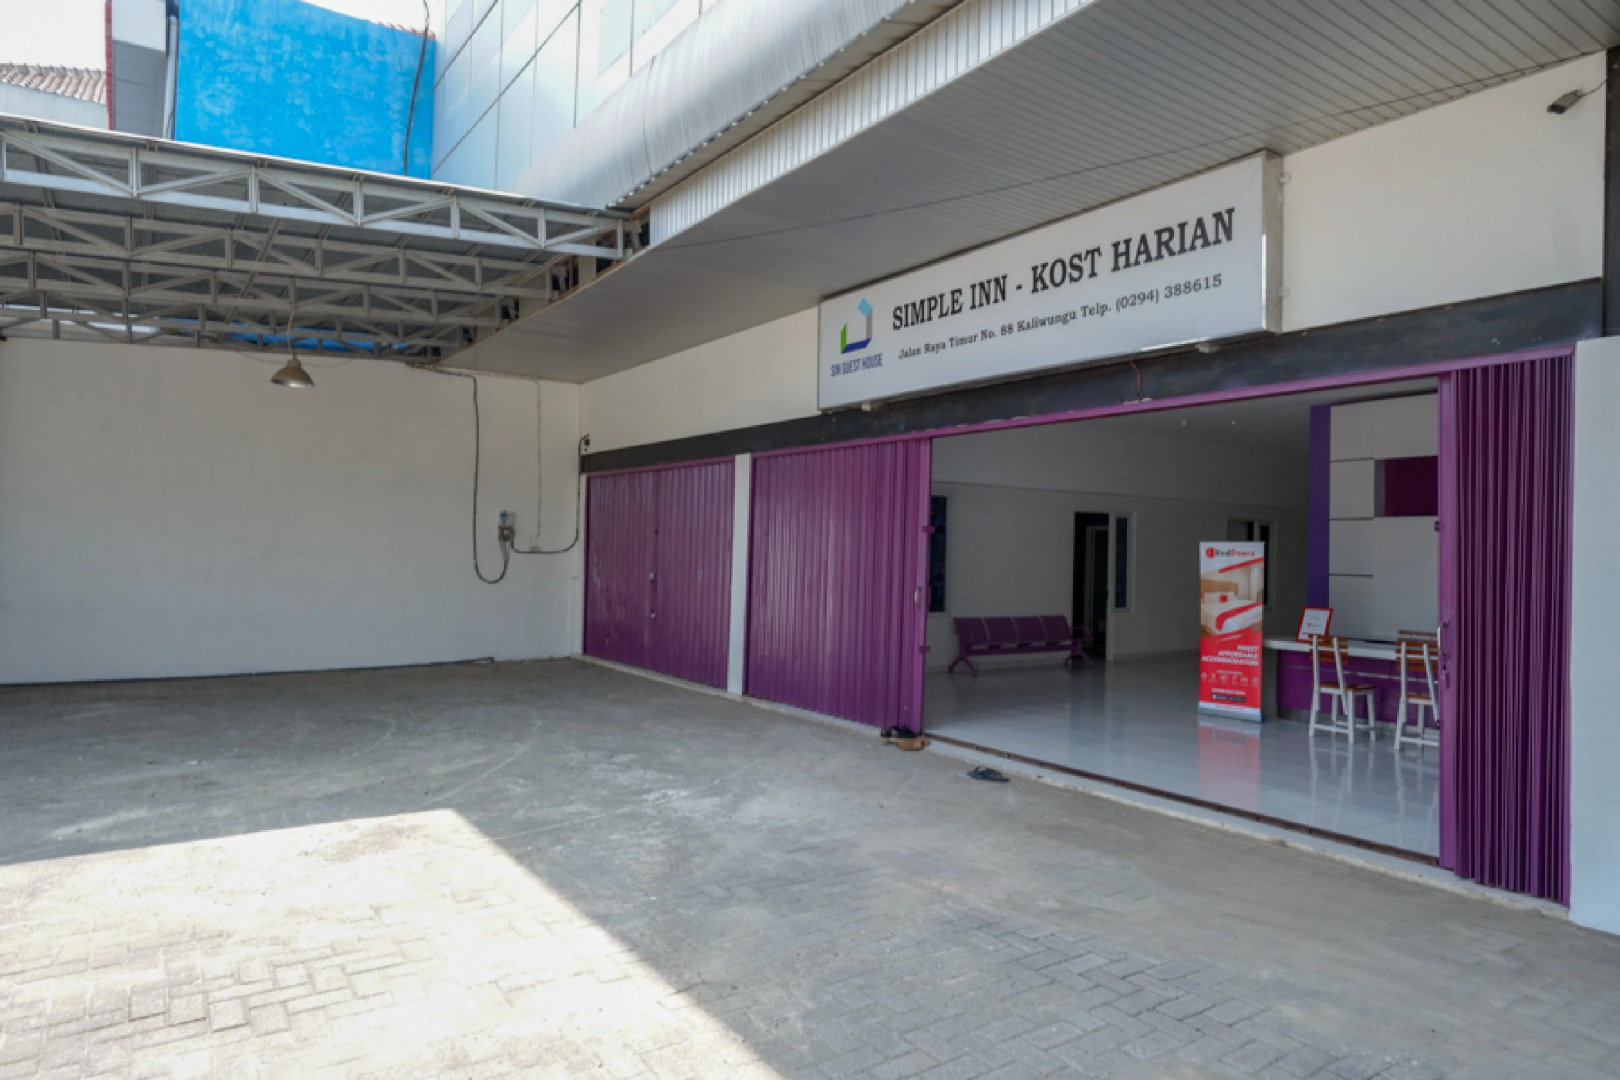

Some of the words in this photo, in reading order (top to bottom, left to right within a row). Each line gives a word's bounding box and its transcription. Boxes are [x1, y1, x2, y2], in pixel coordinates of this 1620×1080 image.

[893, 288, 963, 331] SIMPLE
[970, 274, 1008, 310] INN
[1031, 247, 1102, 294] KOST
[1111, 207, 1235, 273] HARIAN
[898, 344, 921, 359] Jalan
[924, 341, 947, 355] Raya
[949, 333, 978, 348] Timur
[980, 328, 997, 341] No.
[1016, 311, 1077, 334] Kaliwungu
[1081, 302, 1111, 318] Telp.
[1116, 288, 1159, 313] (0294)
[1164, 273, 1222, 300] 388615
[842, 358, 861, 375] GUEST
[862, 353, 883, 370] HOUSE
